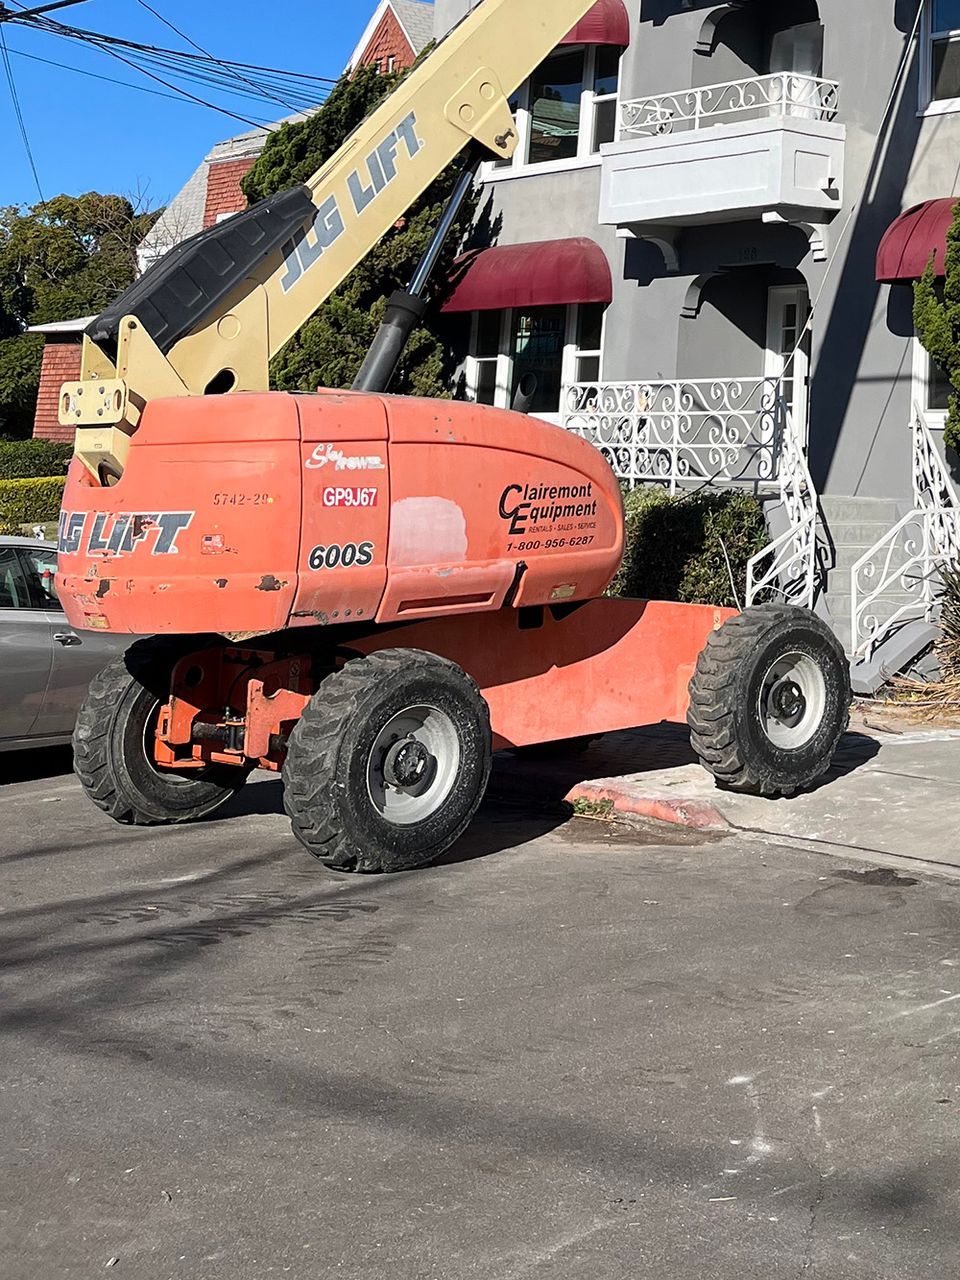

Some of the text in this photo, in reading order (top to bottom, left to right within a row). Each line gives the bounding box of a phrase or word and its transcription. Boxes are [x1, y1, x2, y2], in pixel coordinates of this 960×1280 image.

[280, 110, 420, 295] JLG LIFT
[323, 487, 377, 506] GP9J67
[499, 482, 592, 519] Clairemont
[508, 500, 597, 535] Equipment
[528, 524, 553, 533] RENTALS
[557, 523, 574, 531] SALES
[87, 511, 195, 557] LIFT
[507, 535, 594, 552] 1-800-956-6287
[308, 541, 375, 570] 600S
